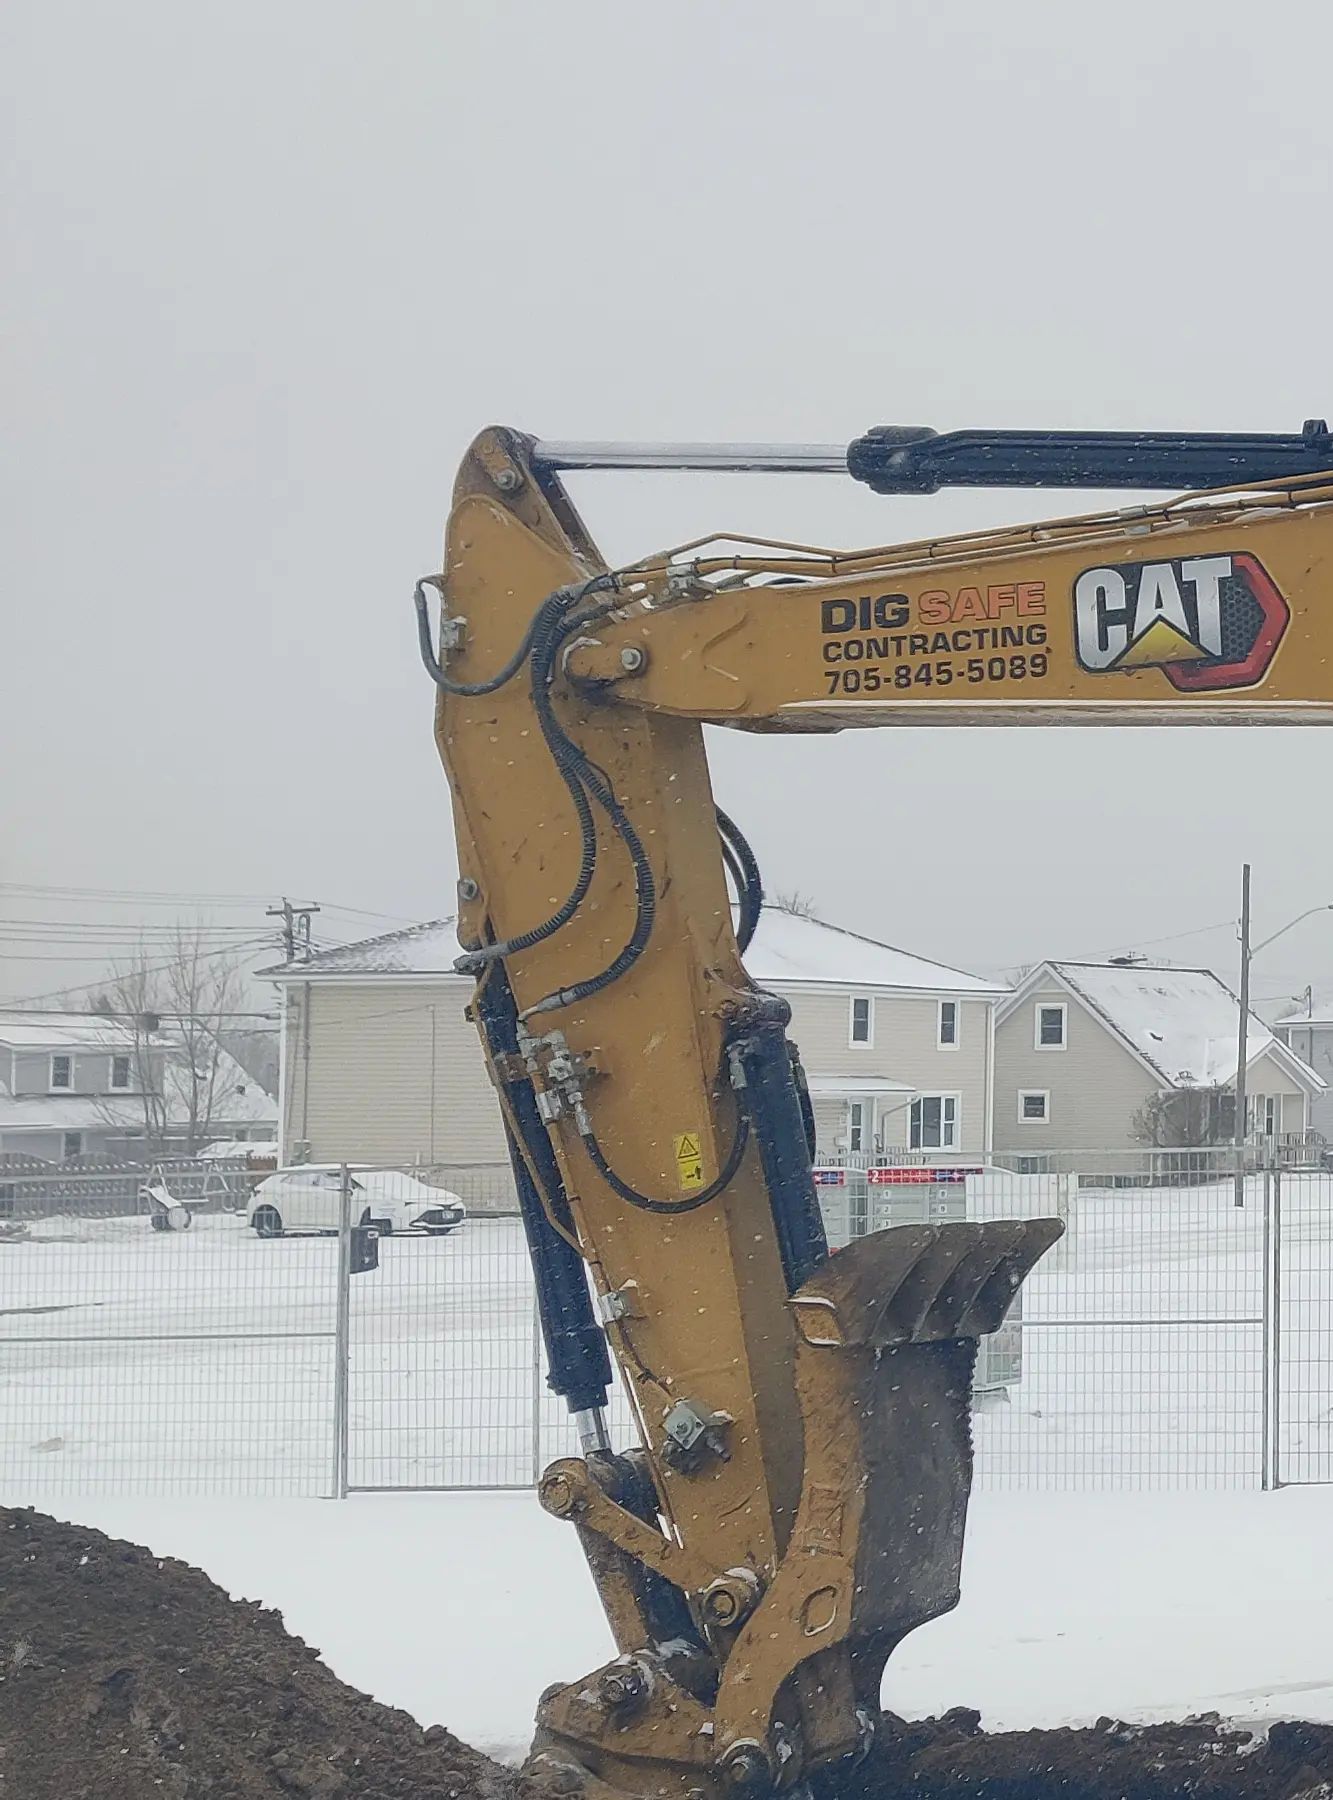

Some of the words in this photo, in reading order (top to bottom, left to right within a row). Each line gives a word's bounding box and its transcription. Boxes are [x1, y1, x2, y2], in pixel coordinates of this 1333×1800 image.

[821, 593, 910, 633] DIG
[918, 581, 1046, 625] SAFE
[1075, 556, 1232, 669] CAT
[822, 624, 1047, 662] CONTRACTING
[824, 653, 1048, 694] 705-845-5089
